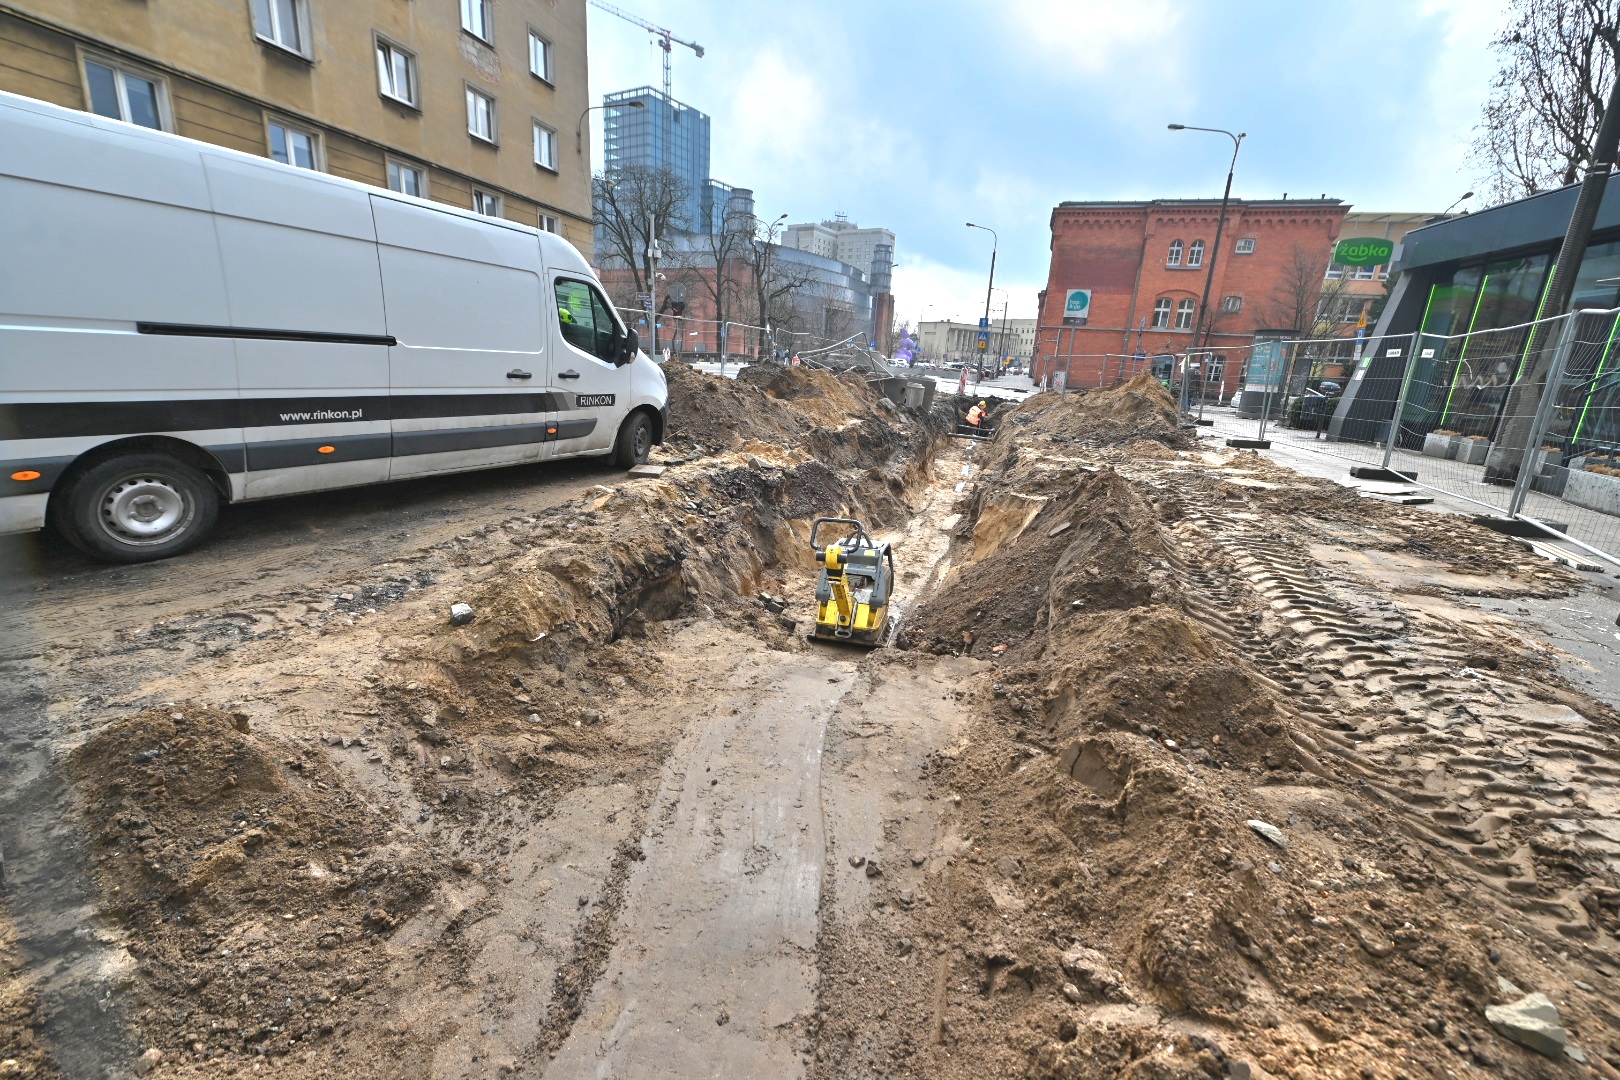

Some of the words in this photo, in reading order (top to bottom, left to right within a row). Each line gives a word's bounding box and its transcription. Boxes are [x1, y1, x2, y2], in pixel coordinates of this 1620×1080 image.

[1340, 243, 1389, 256] żabka
[580, 395, 612, 406] RINKON
[279, 408, 363, 421] www.rinkon.pl
